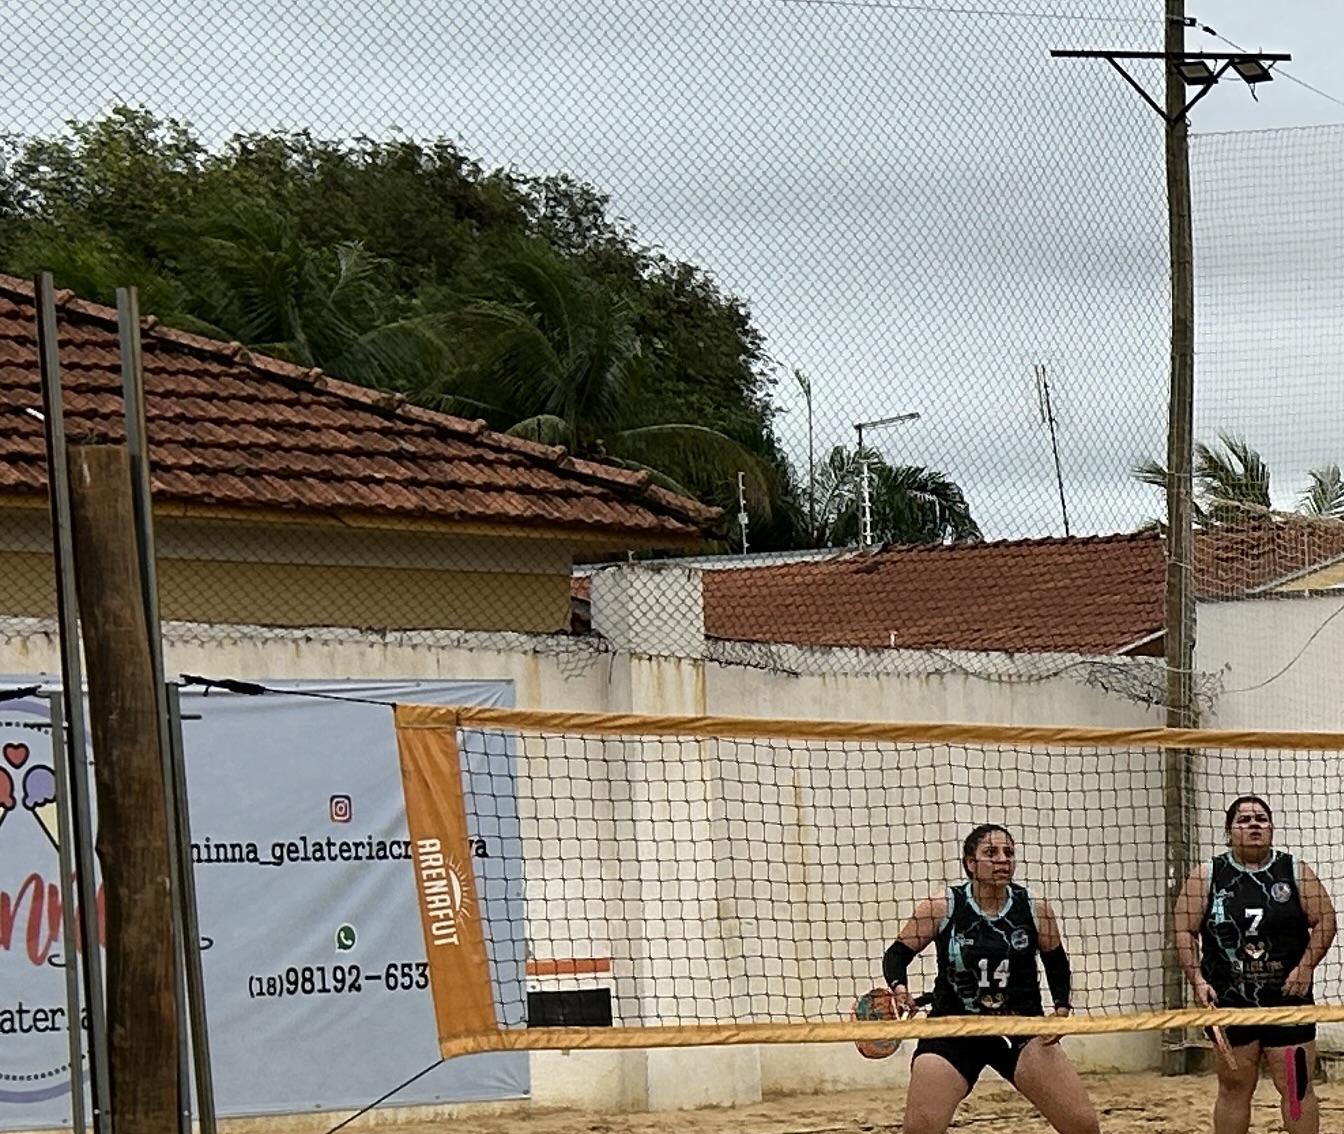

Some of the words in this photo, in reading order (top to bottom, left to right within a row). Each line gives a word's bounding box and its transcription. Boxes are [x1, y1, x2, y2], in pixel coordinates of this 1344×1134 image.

[417, 838, 459, 946] ARENAFUT
[1244, 907, 1264, 937] 7
[248, 961, 430, 998] (18)98192-653
[978, 957, 1011, 988] 14
